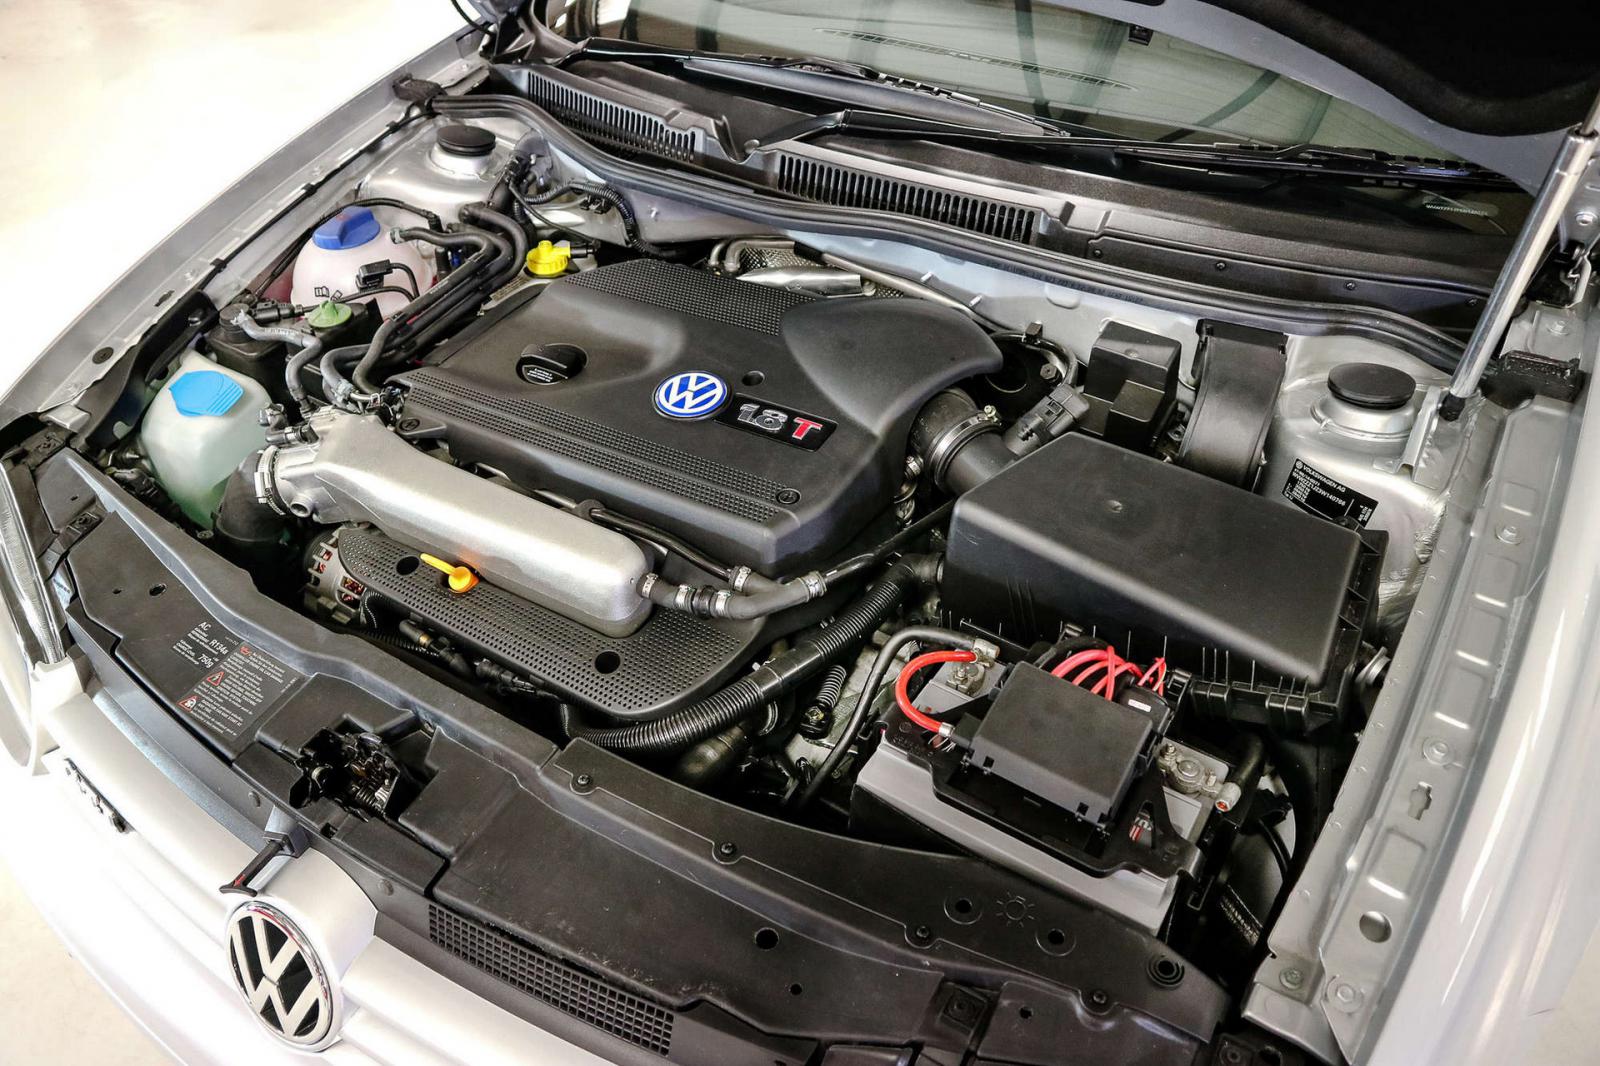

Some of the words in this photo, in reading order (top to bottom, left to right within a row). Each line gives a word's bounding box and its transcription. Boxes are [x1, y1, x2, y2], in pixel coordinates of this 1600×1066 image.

[1303, 465, 1337, 487] VOLKSWAGEN
[1336, 484, 1346, 493] AG
[199, 621, 212, 631] AC
[209, 639, 229, 655] R134a
[198, 653, 215, 669] 750g
